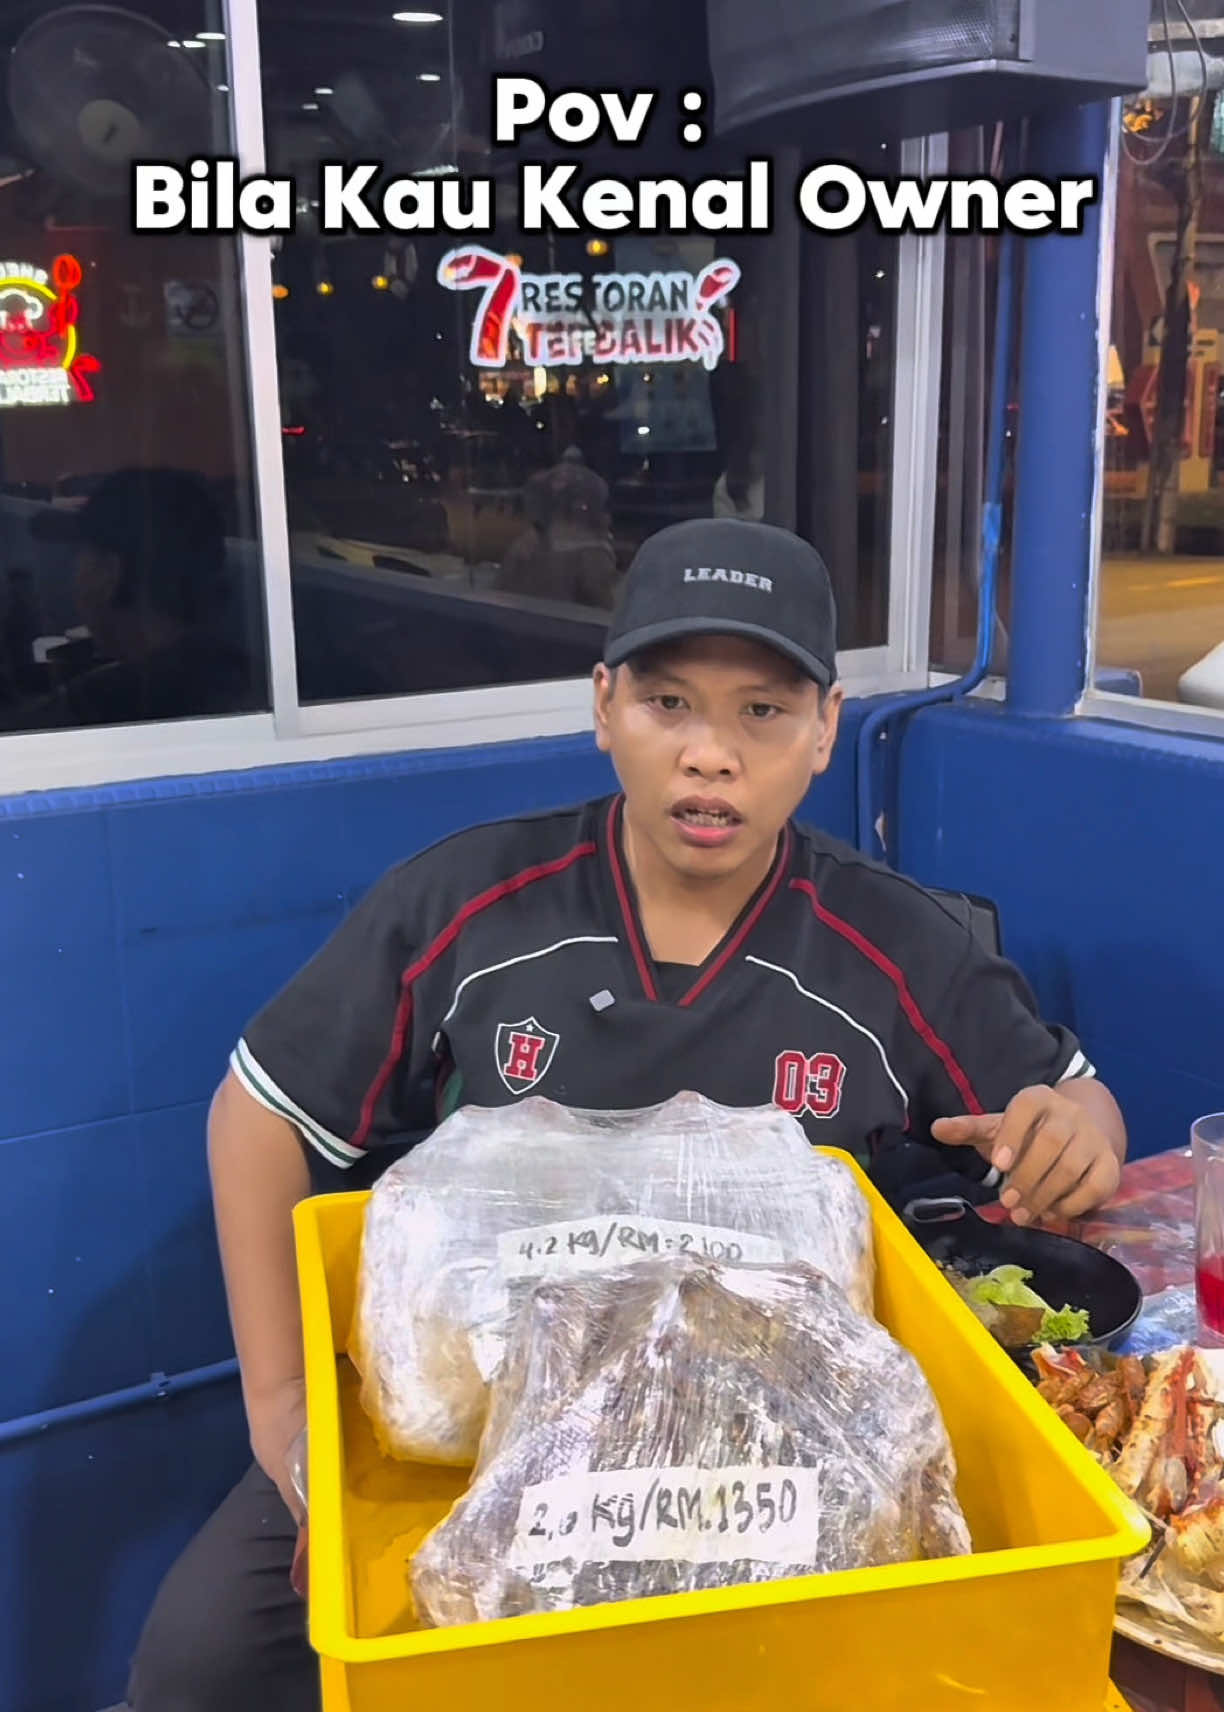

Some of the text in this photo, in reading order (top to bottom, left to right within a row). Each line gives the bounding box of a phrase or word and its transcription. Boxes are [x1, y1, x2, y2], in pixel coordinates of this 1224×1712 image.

[683, 567, 773, 592] LEADER
[503, 1031, 546, 1081] H
[773, 1050, 847, 1118] 03
[519, 1236, 557, 1261] 4.2
